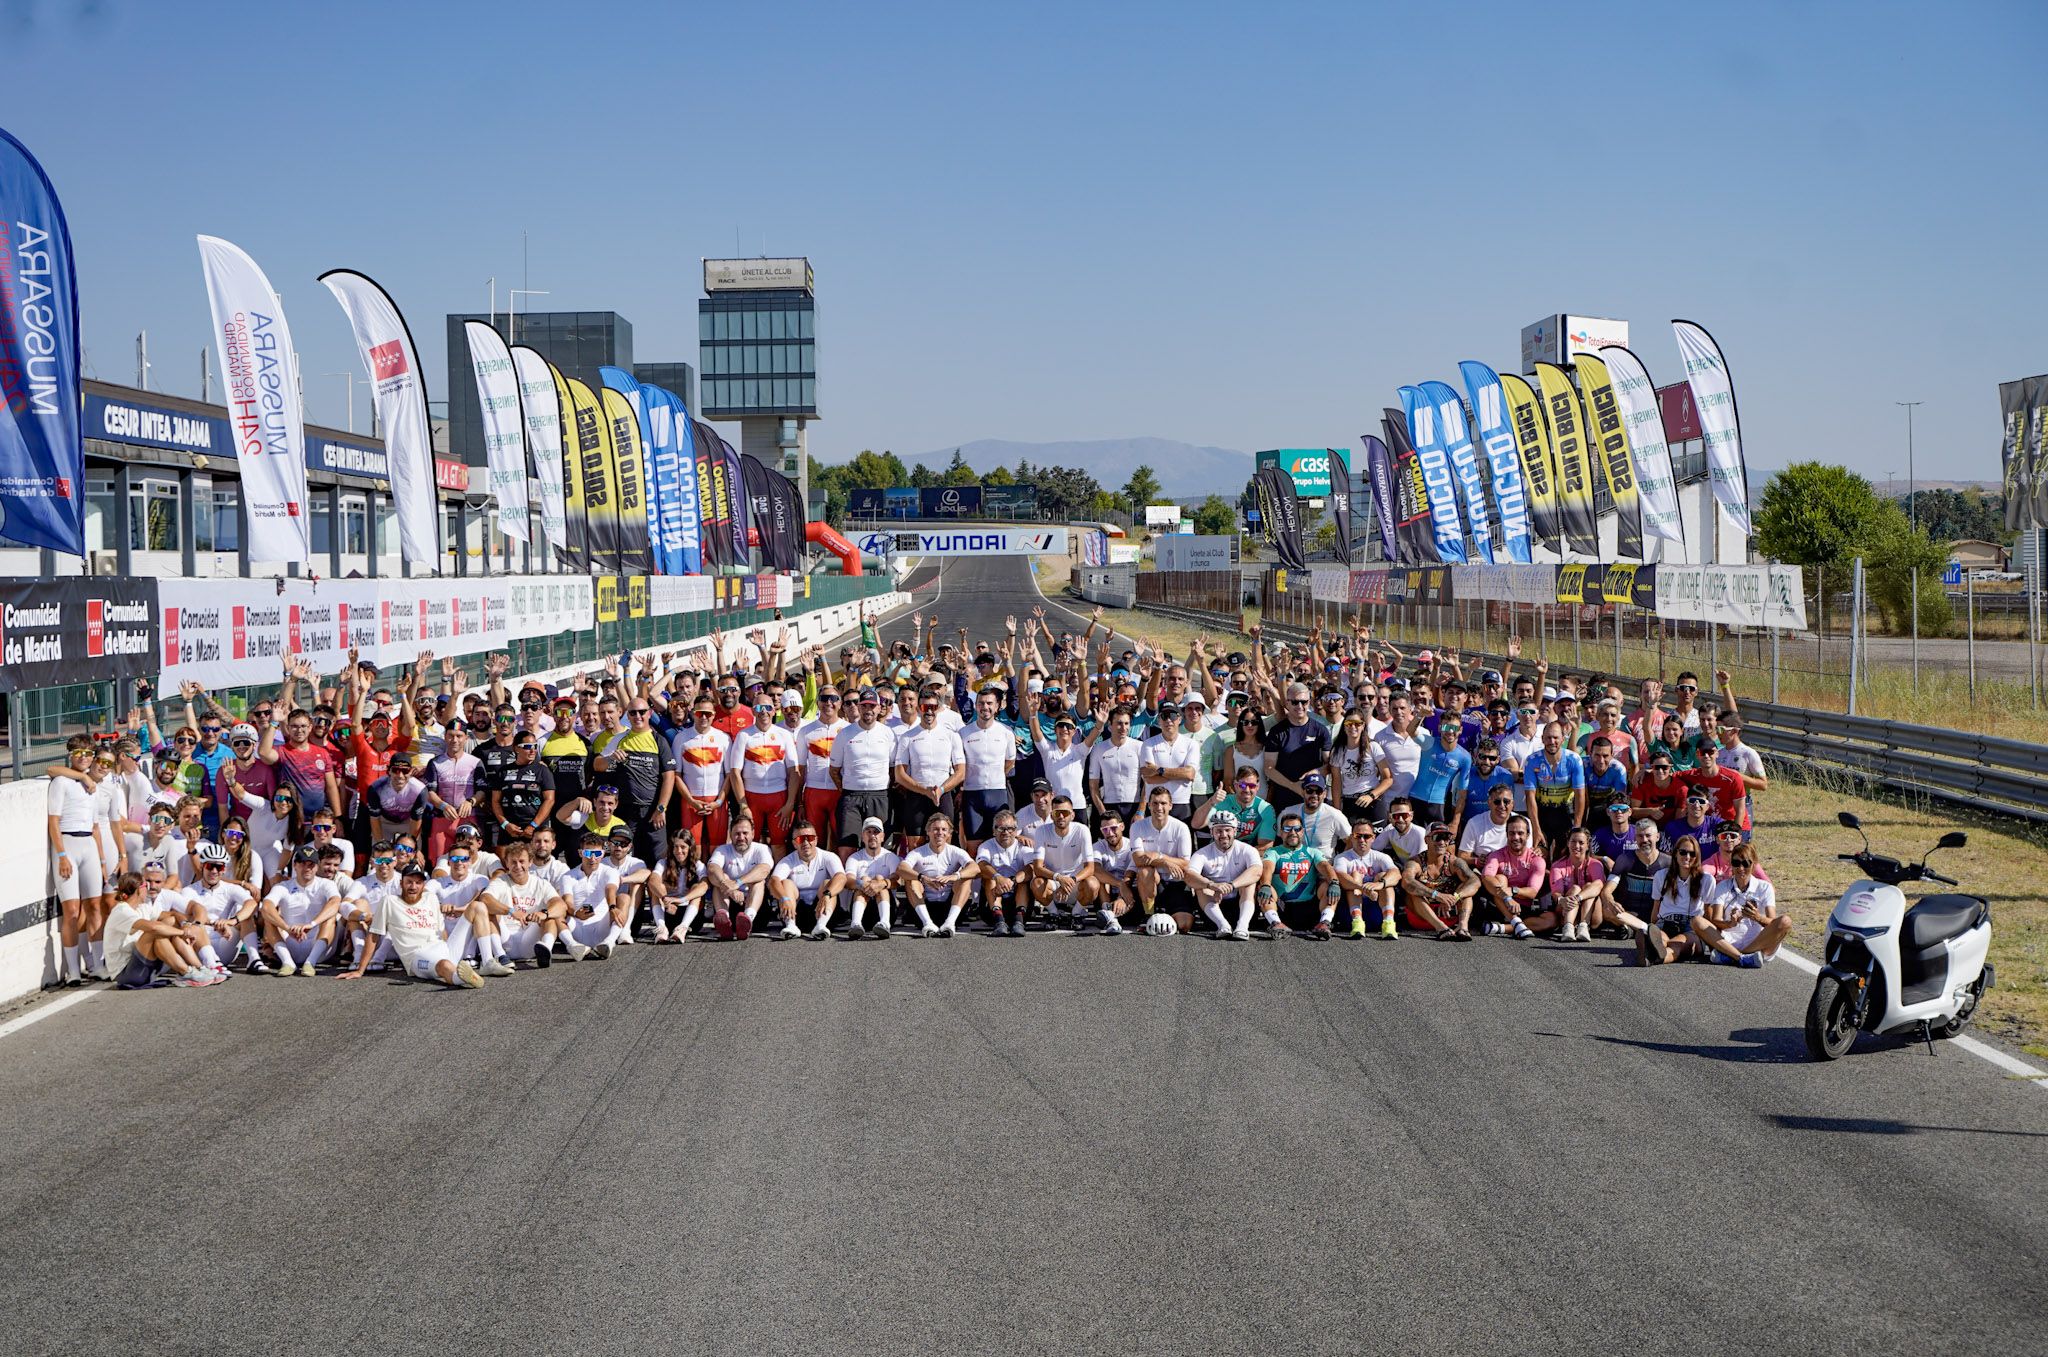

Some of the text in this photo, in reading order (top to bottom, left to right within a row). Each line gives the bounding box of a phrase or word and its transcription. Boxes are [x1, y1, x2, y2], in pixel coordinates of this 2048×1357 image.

[104, 403, 211, 448] CESUR INTEA JARAMA
[1300, 457, 1330, 473] case
[920, 534, 1006, 551] YUNDAI
[5, 602, 61, 629] Comunidad
[104, 600, 149, 623] Comunidad
[5, 634, 62, 665] de Madrid
[1237, 822, 1254, 832] ERN
[1282, 861, 1309, 870] KERN
